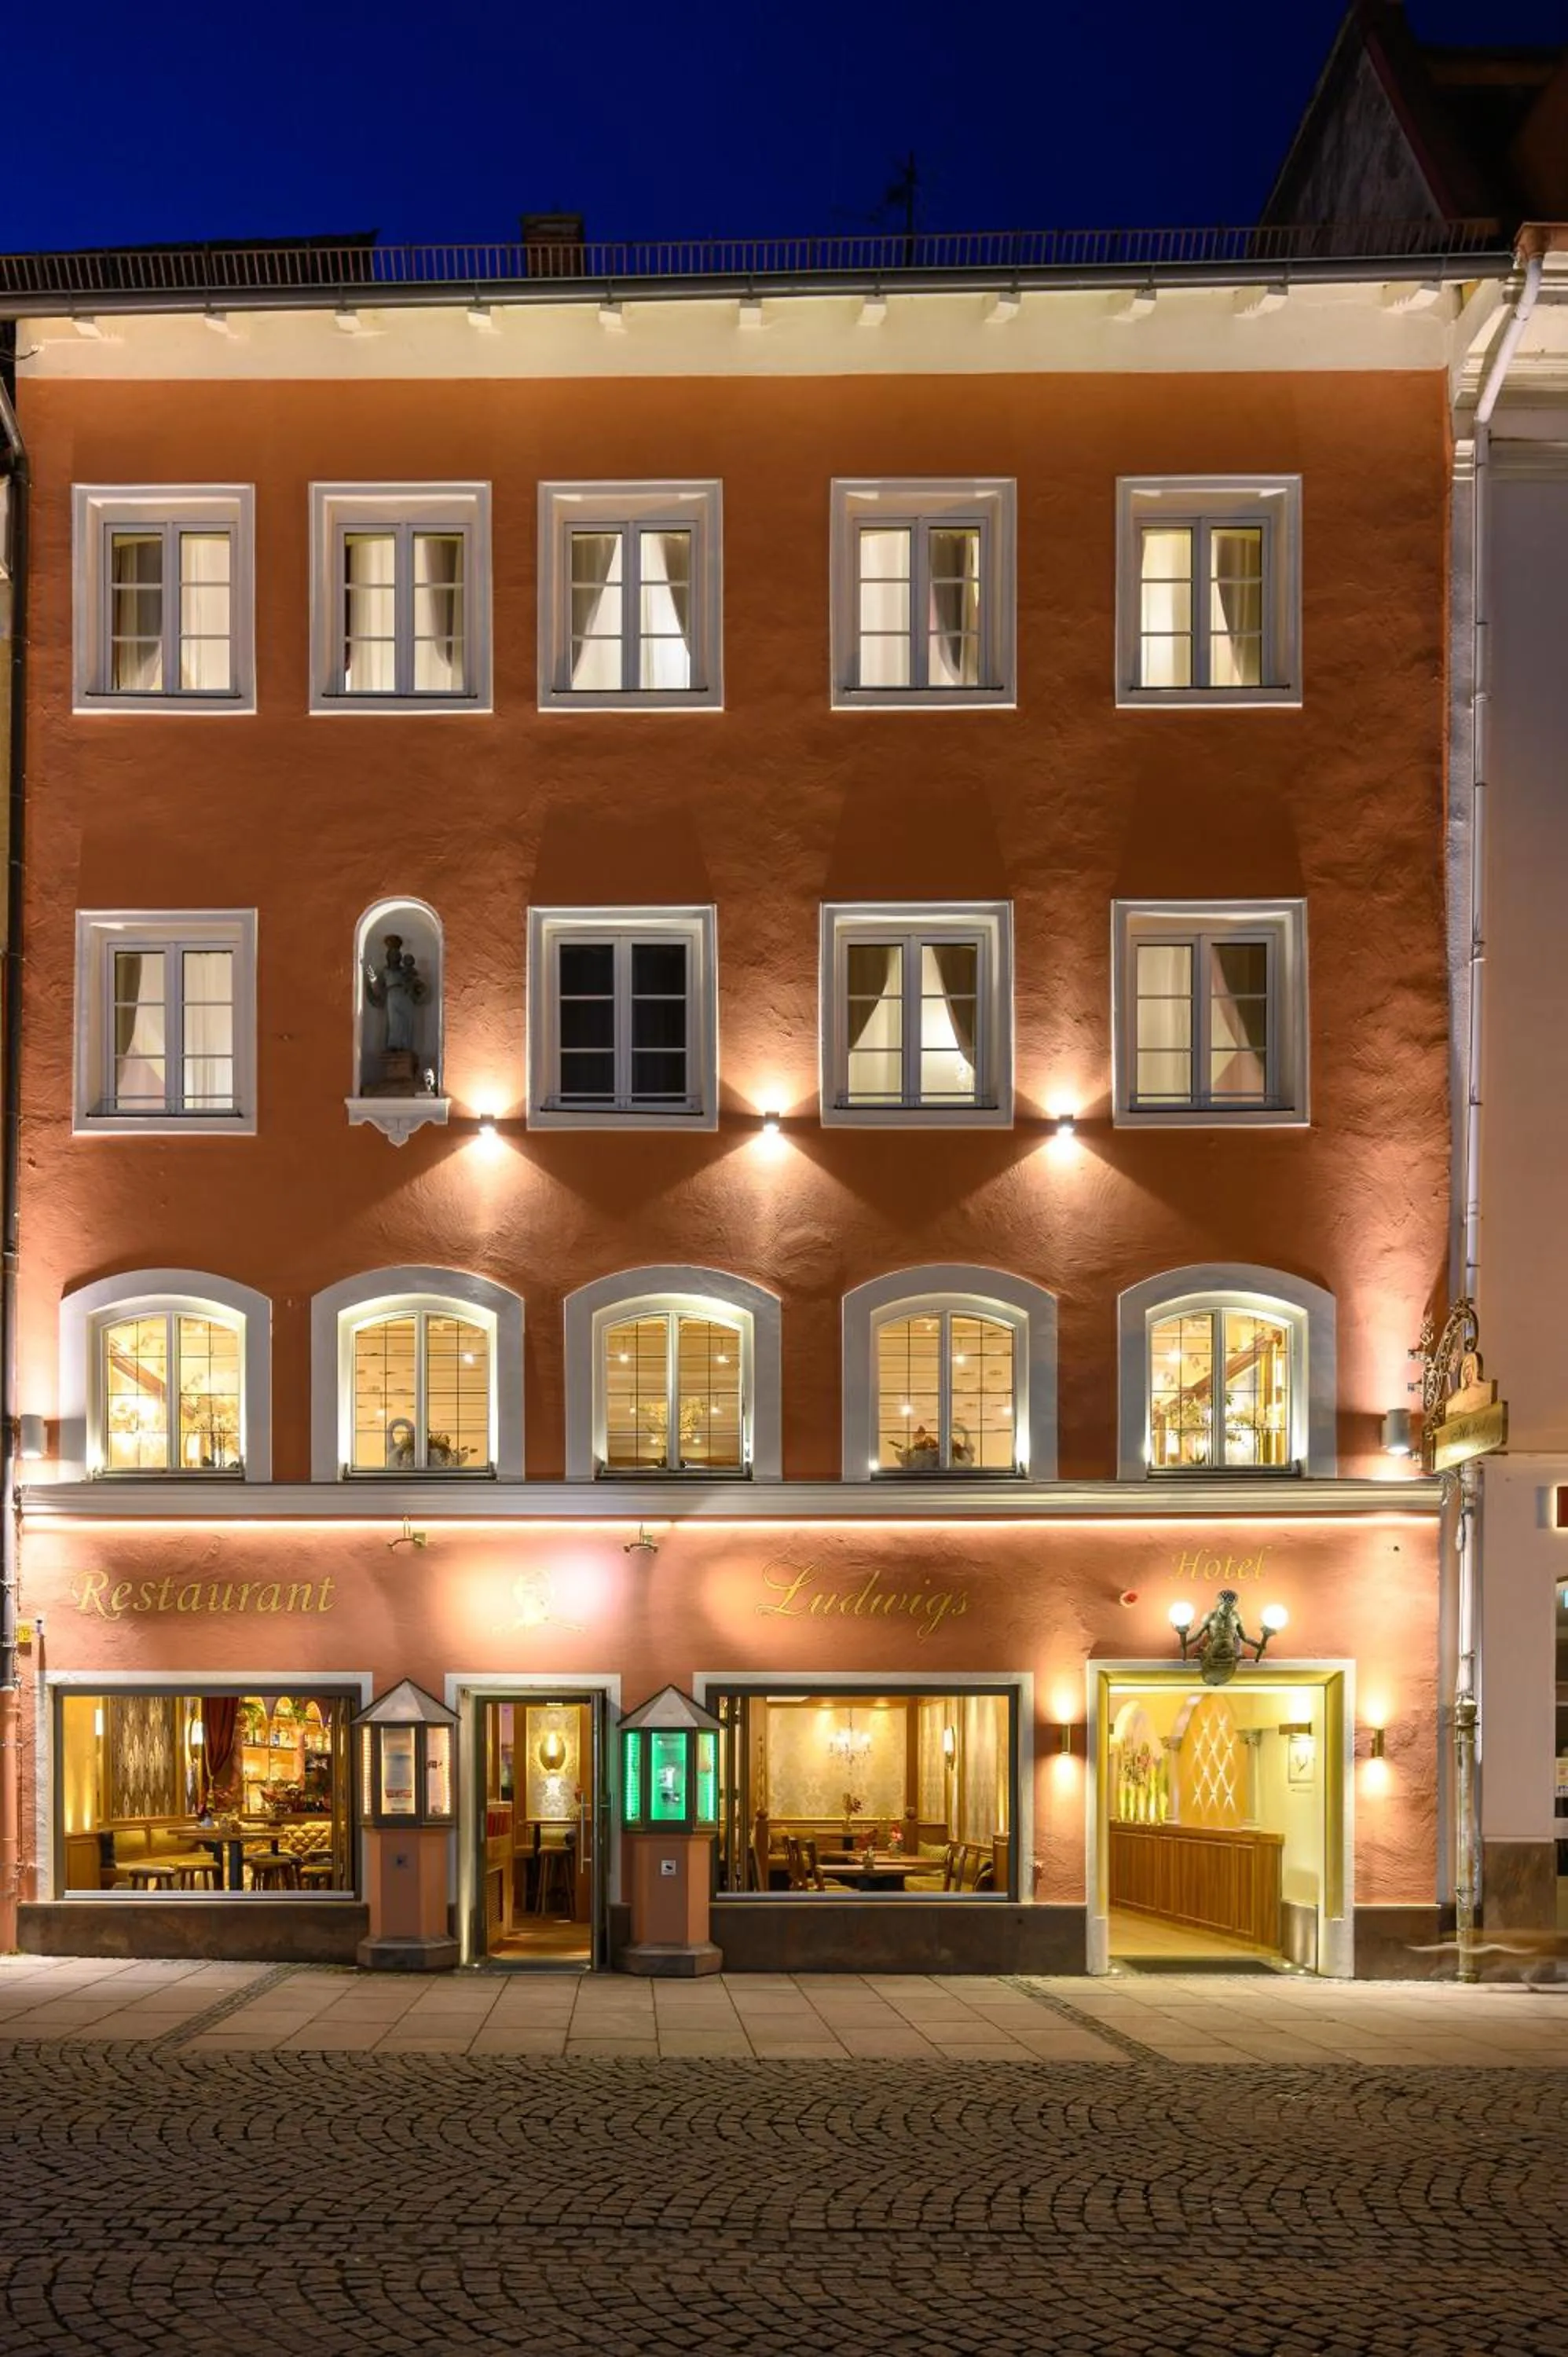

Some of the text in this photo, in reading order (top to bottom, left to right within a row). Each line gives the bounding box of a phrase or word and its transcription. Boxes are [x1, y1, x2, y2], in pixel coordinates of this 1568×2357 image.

[1167, 1545, 1273, 1580] Hotel
[71, 1570, 335, 1621] Restaurant
[756, 1561, 969, 1645] Ludwigs
